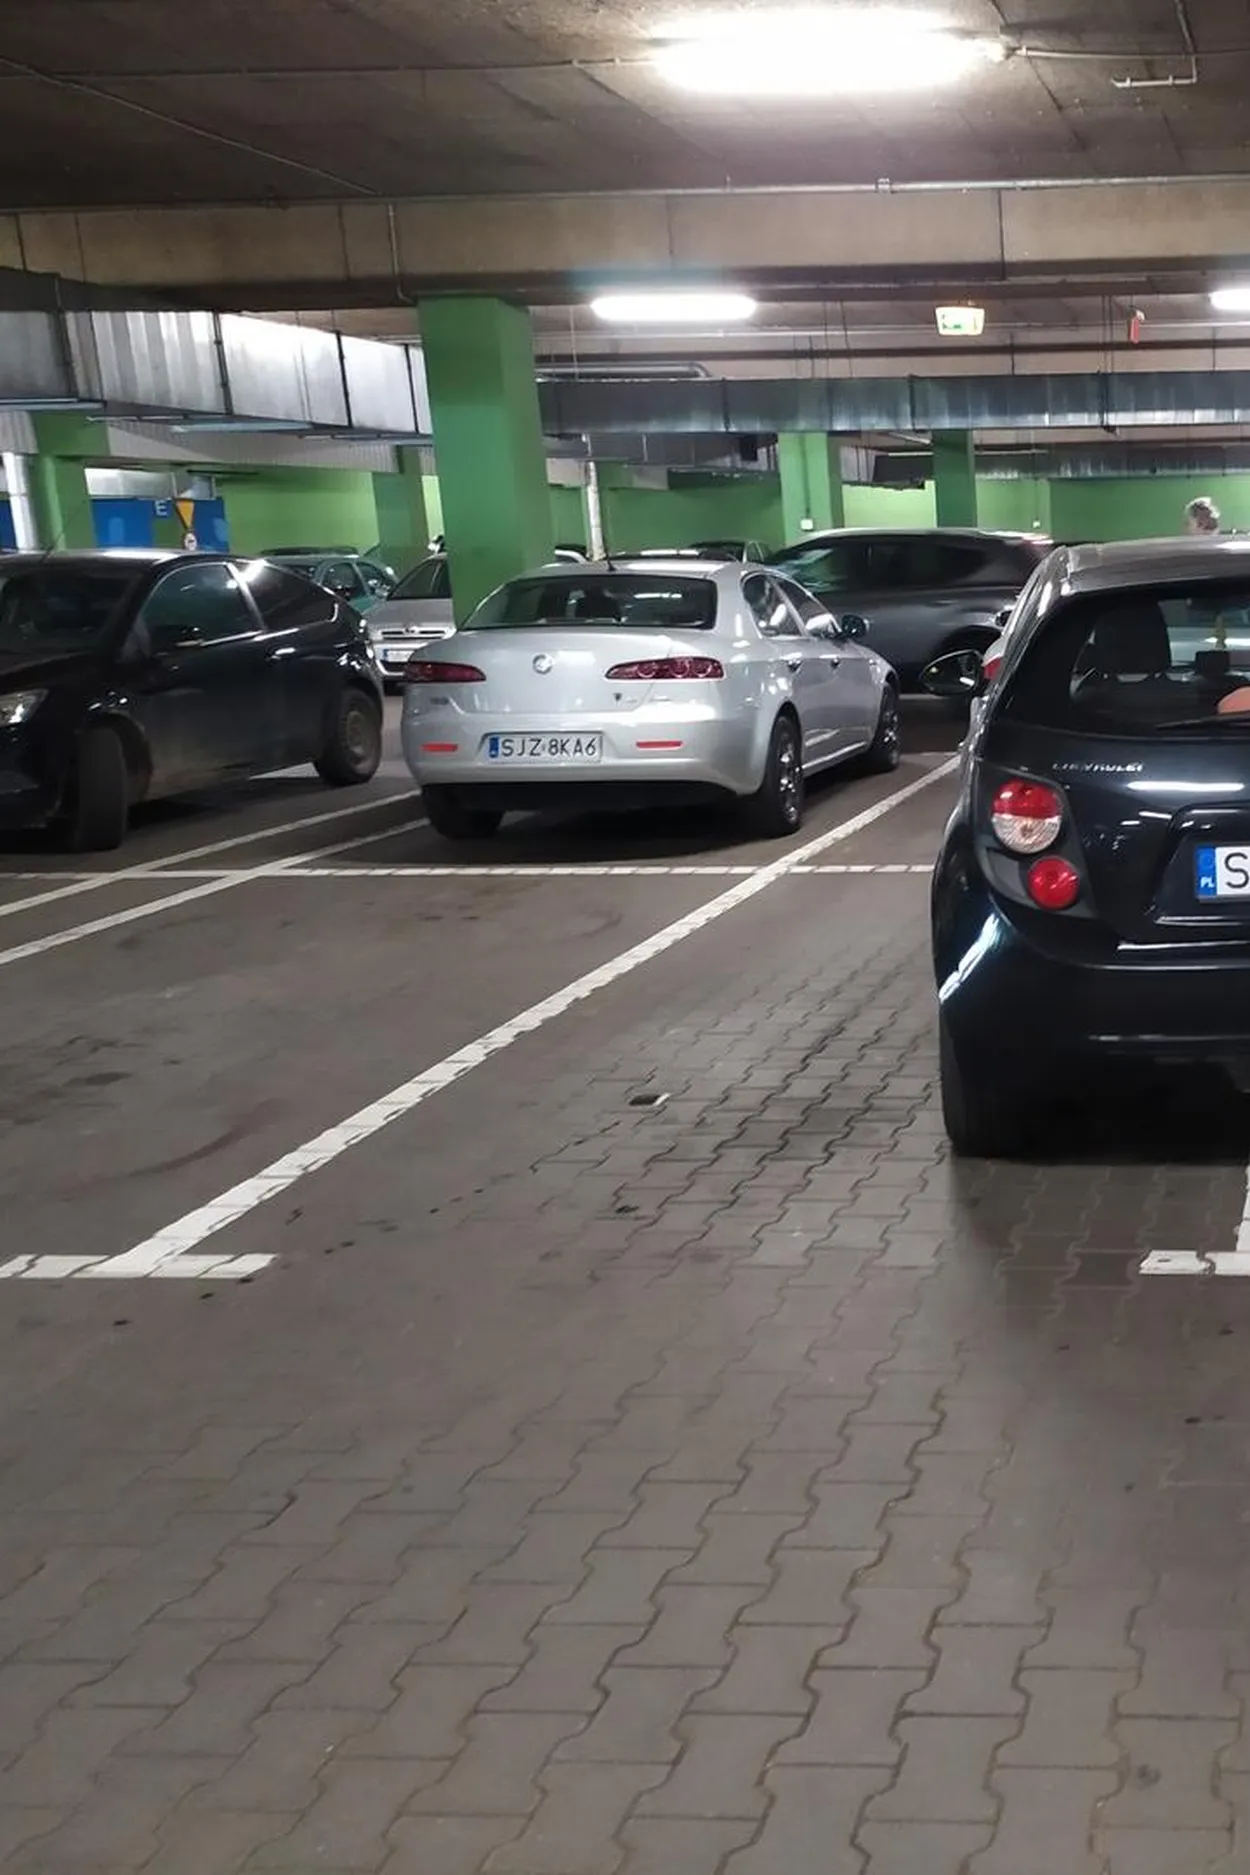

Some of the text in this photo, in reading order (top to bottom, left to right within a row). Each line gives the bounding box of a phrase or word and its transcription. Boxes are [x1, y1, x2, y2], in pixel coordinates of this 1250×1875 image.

[501, 737, 597, 757] SJZ 8KA6
[1200, 877, 1215, 888] PL
